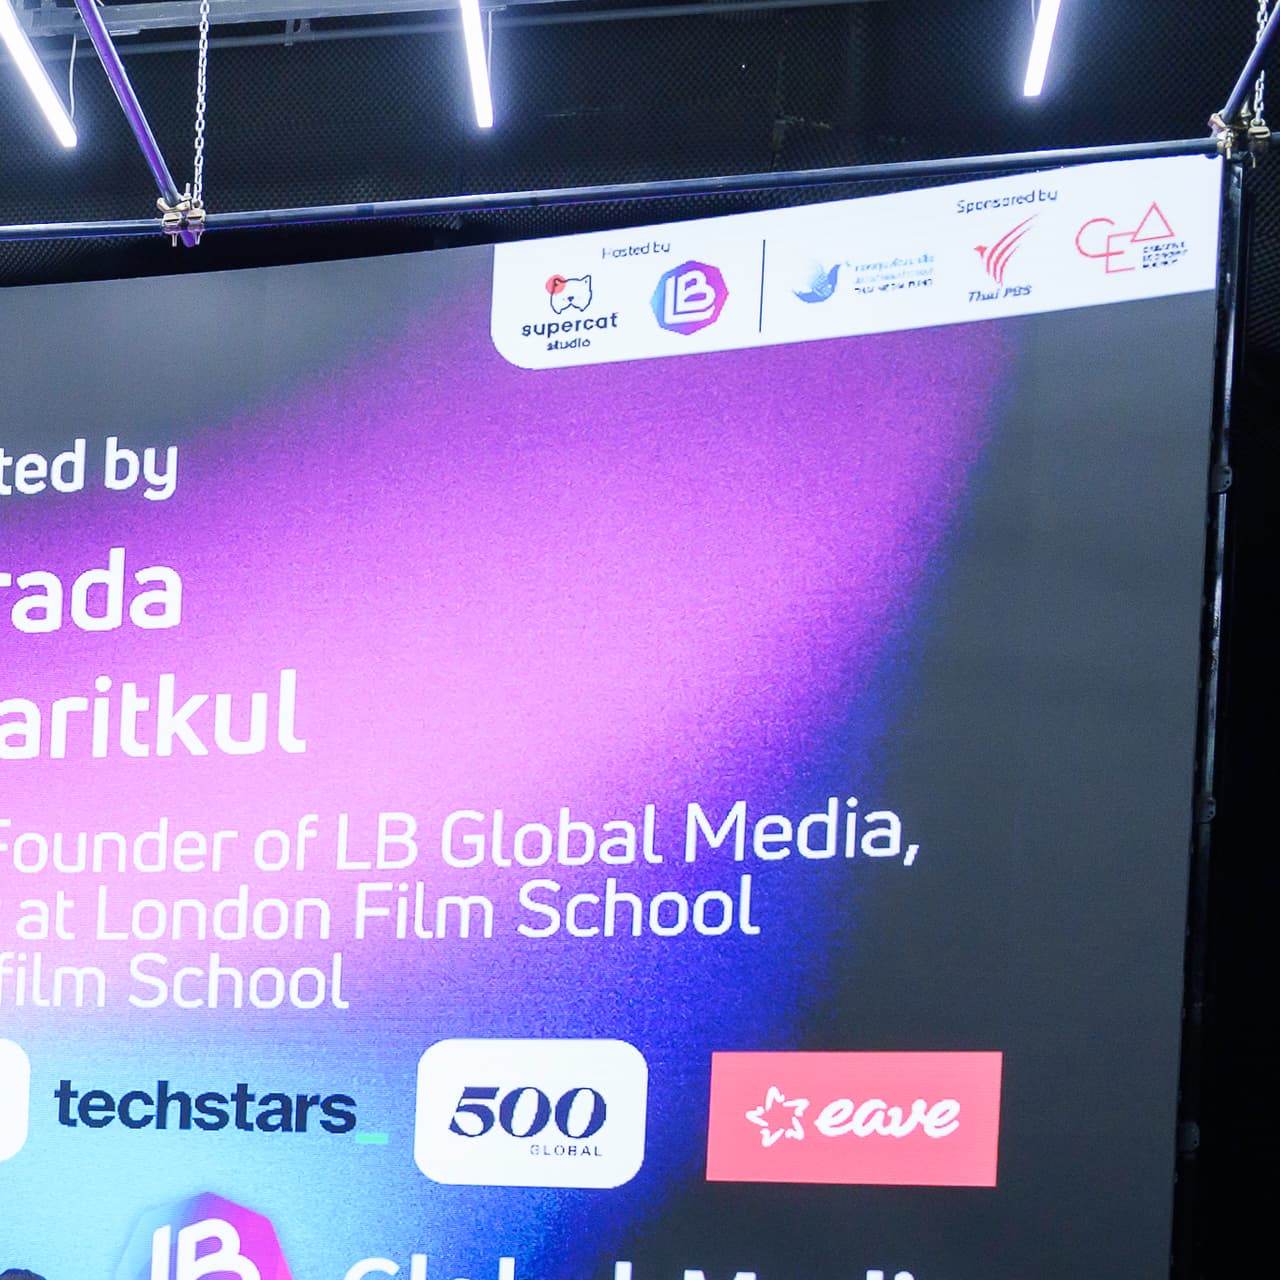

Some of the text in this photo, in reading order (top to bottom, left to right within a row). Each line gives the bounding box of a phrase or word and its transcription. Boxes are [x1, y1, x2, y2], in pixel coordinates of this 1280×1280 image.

[521, 312, 620, 339] supercat
[546, 337, 591, 351] studio
[104, 436, 178, 501] by
[252, 813, 319, 872] of
[336, 811, 419, 870] LB
[441, 803, 664, 869] Global
[684, 796, 920, 867] Media,
[15, 890, 76, 941] at
[95, 883, 331, 941] London
[354, 880, 494, 940] Film
[516, 873, 761, 939] School
[127, 951, 350, 1010] School
[53, 1079, 358, 1135] techstars
[447, 1085, 608, 1138] 500
[814, 1097, 962, 1139] eave
[529, 1143, 604, 1158] GLOBAL
